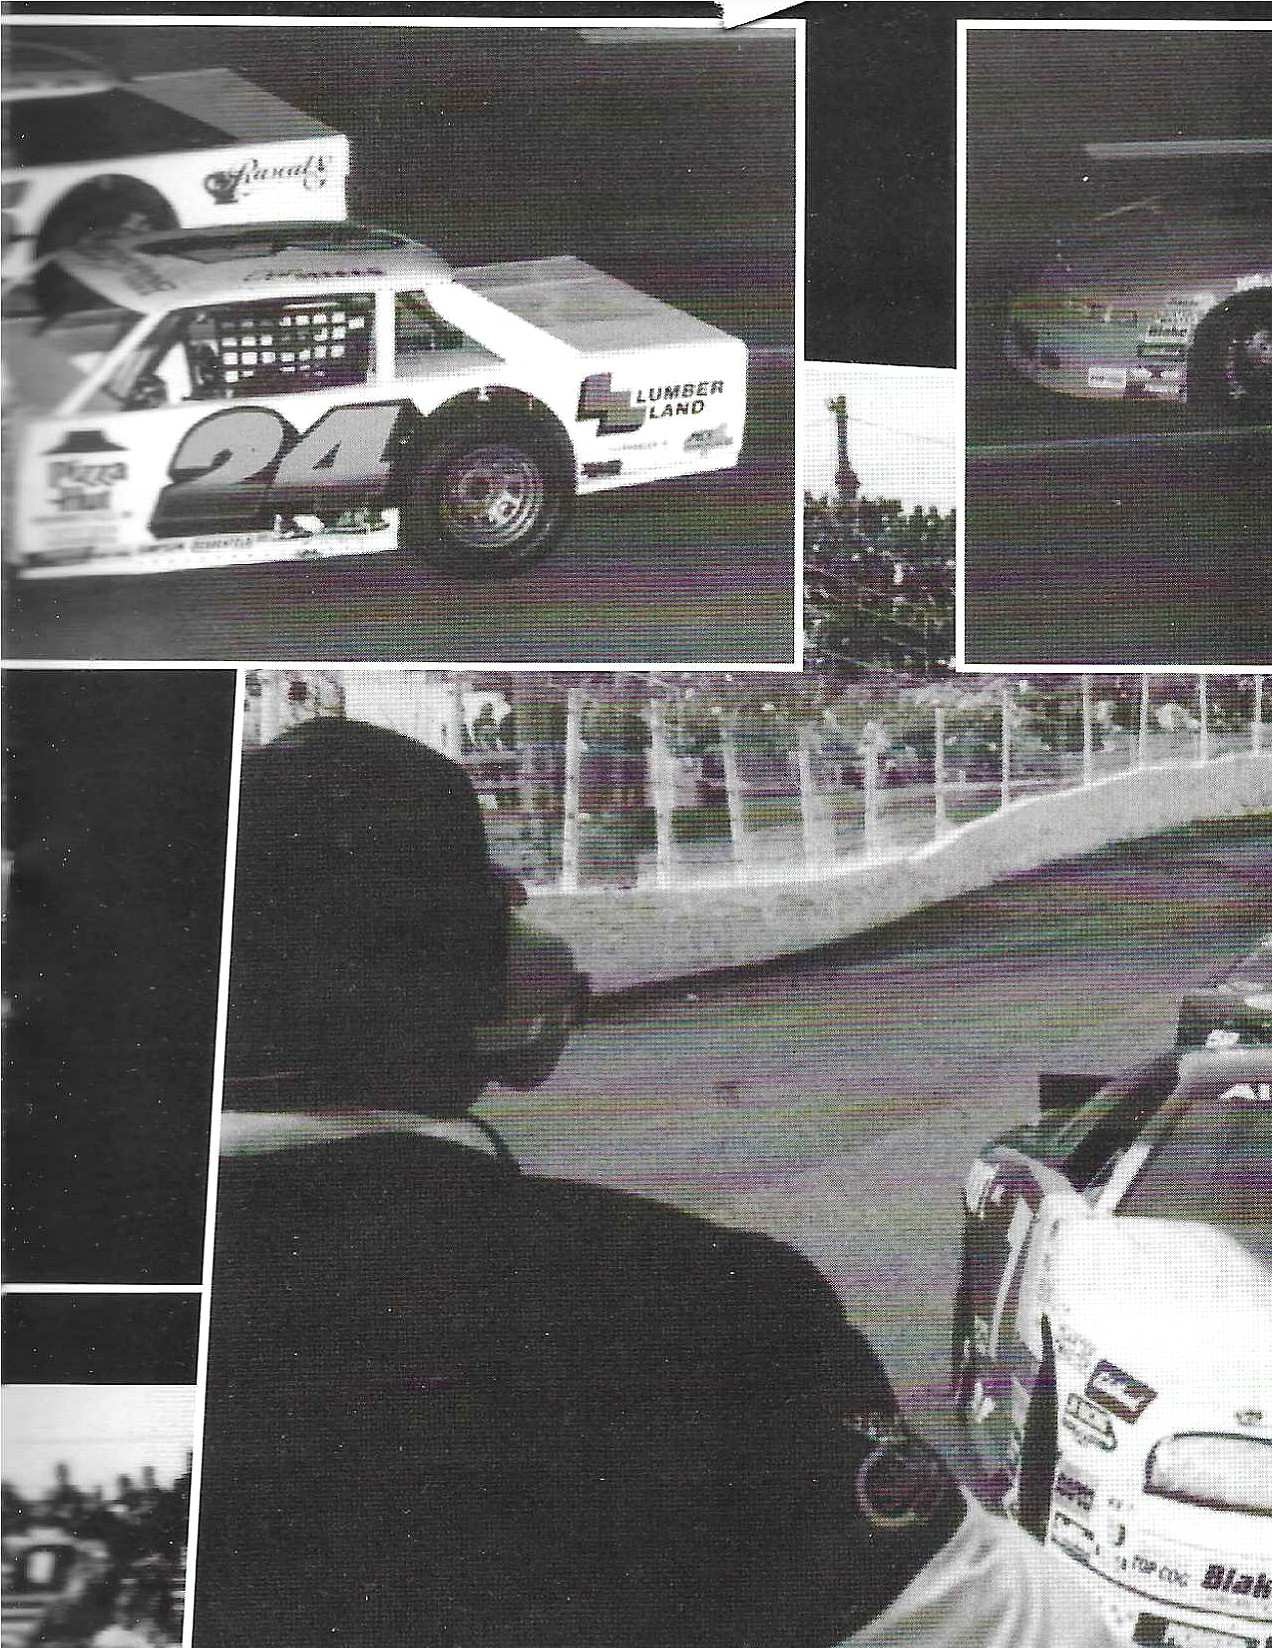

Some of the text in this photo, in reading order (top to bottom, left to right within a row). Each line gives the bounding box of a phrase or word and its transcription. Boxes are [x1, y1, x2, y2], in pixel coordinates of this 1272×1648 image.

[635, 380, 725, 404] LUMBER
[649, 400, 705, 419] LAND
[147, 399, 428, 538] 24
[1131, 1553, 1159, 1575] TOP
